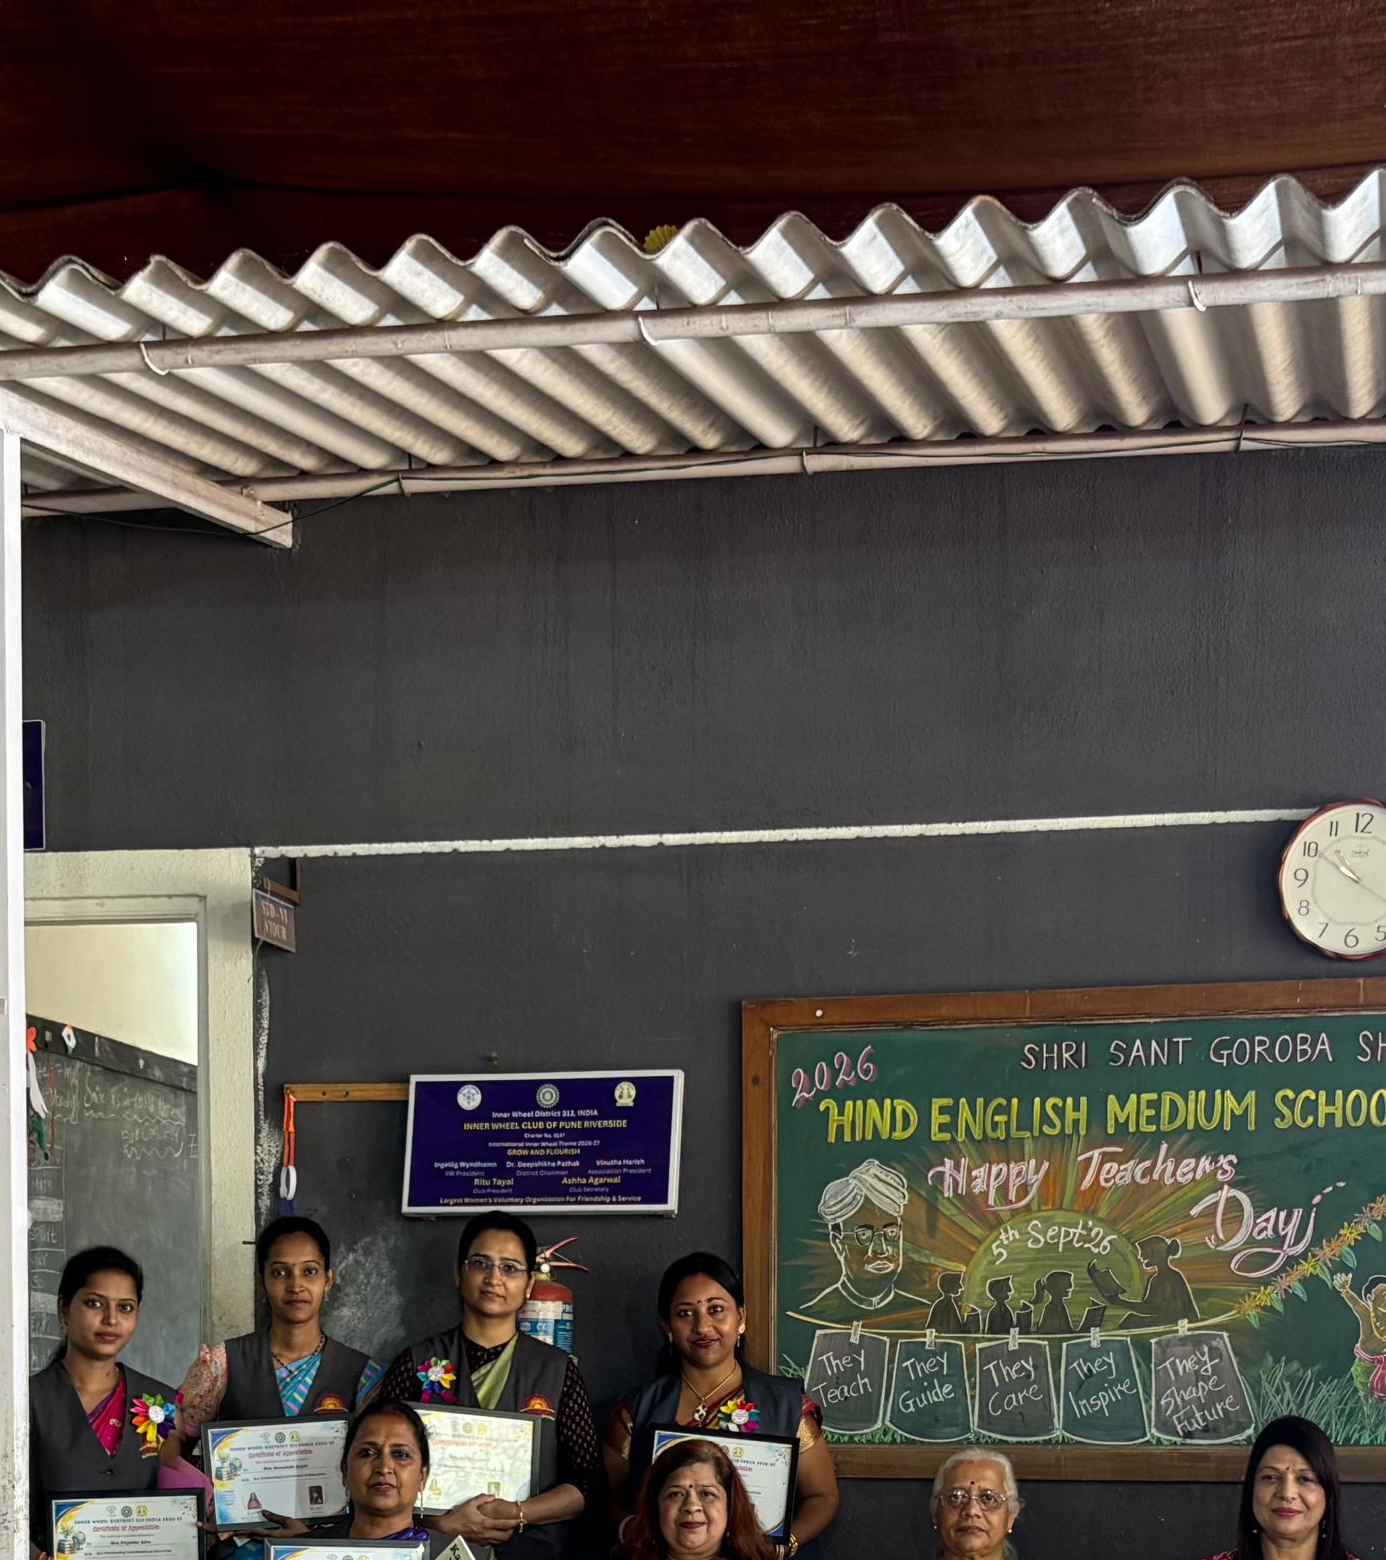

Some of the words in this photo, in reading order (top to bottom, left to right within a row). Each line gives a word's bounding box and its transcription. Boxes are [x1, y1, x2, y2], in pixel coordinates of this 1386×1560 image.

[1329, 821, 1338, 837] 11
[1355, 812, 1374, 833] 12
[1303, 841, 1318, 857] 10
[1293, 868, 1308, 888] 9
[1297, 900, 1310, 916] 8
[1318, 922, 1329, 938] 7
[1344, 928, 1359, 948] 6
[1375, 925, 1386, 941] 5
[1020, 1041, 1087, 1071] SHRI
[1109, 1037, 1192, 1067] SANT
[1210, 1033, 1333, 1066] GOROBA
[791, 1045, 878, 1107] 2026
[584, 1120, 627, 1128] RIVERSIDE
[819, 1097, 918, 1143] HIND
[931, 1095, 1087, 1141] ENGLISH
[1108, 1088, 1256, 1133] MEDIUM
[493, 1178, 514, 1187] Tayal
[928, 1156, 1049, 1212] Happy
[1190, 1184, 1317, 1277] Day
[992, 1226, 1020, 1266] 5th
[818, 1349, 867, 1376] They
[902, 1355, 948, 1384] They
[984, 1355, 1034, 1385] They
[1069, 1351, 1115, 1380] They
[1157, 1344, 1219, 1380] They
[812, 1374, 872, 1407] Teach
[899, 1382, 955, 1415] Guide
[989, 1383, 1043, 1416] Care
[1068, 1373, 1138, 1420] Inspire
[1173, 1395, 1240, 1436] Future
